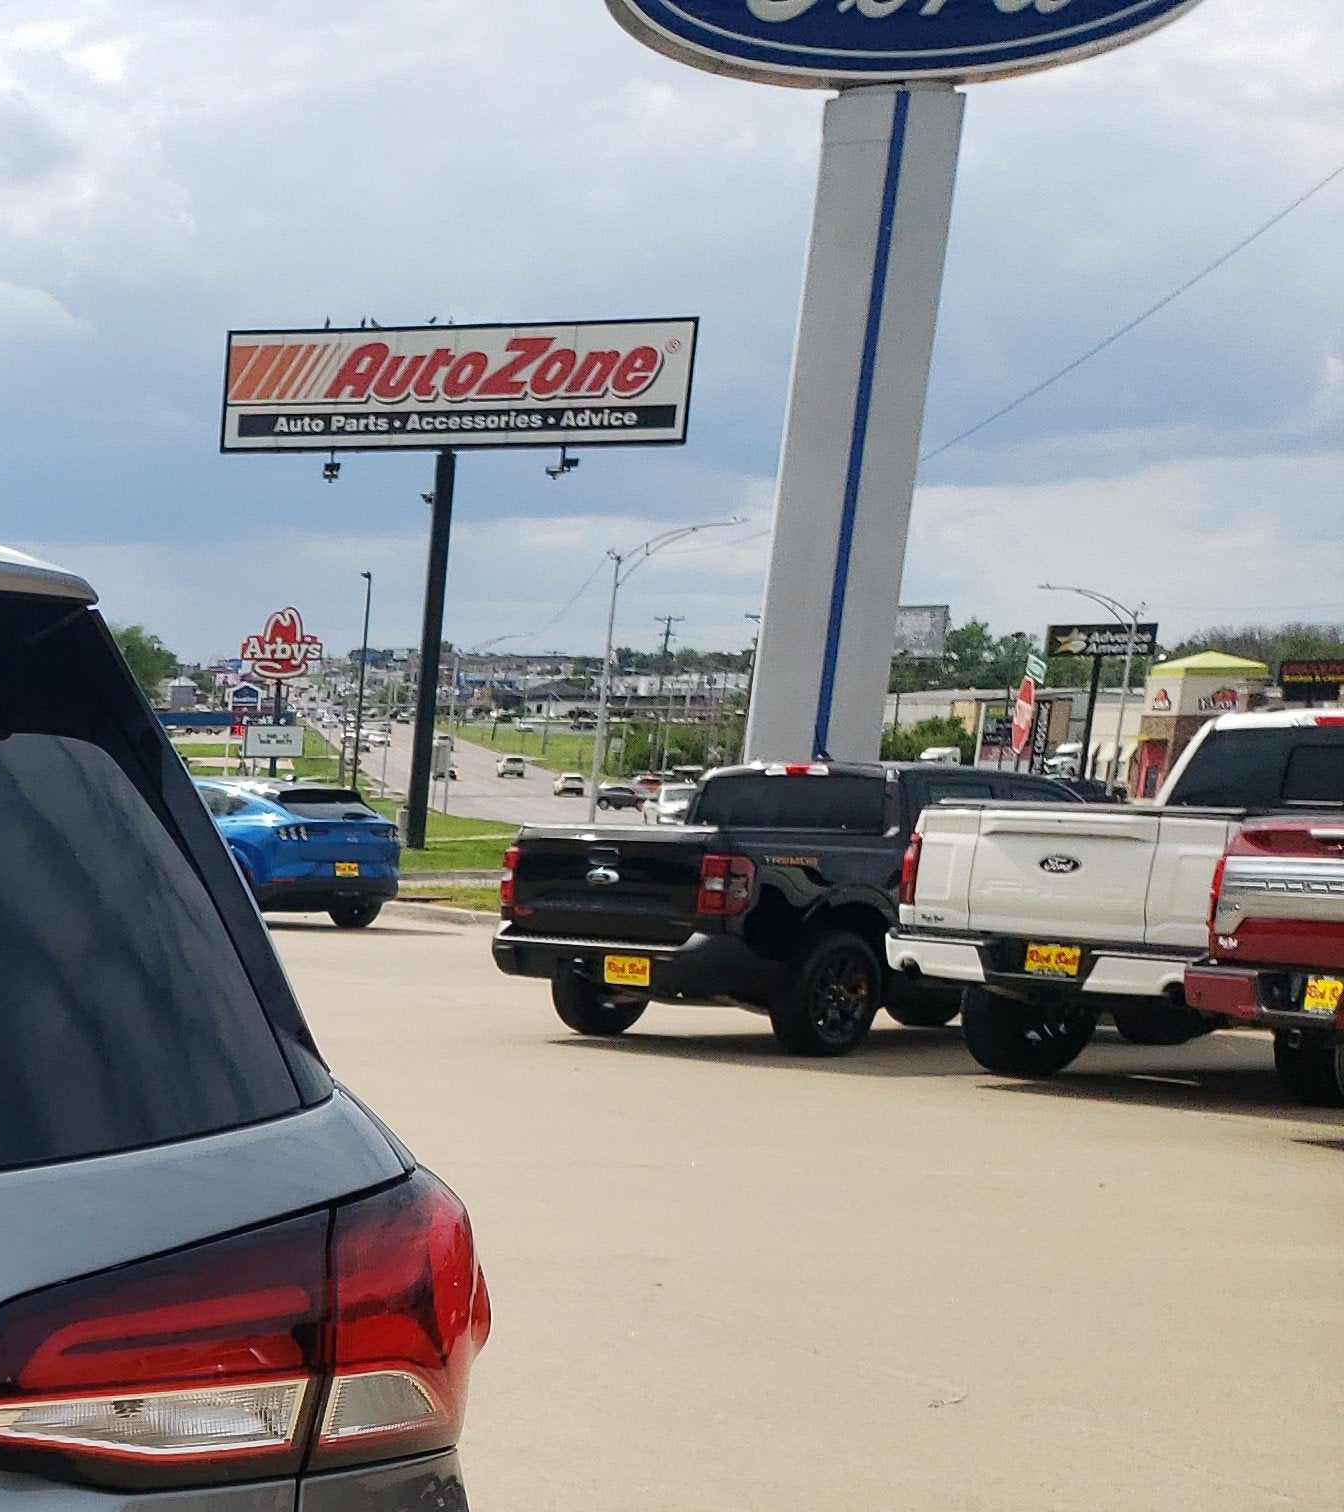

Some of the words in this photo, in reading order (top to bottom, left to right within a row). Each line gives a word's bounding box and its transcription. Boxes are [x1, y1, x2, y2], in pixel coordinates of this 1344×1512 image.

[324, 336, 664, 401] AutoZone
[273, 414, 324, 434] Auto
[330, 413, 389, 432] Parts
[405, 411, 543, 430] Accessories
[560, 408, 637, 428] Advice
[243, 636, 322, 665] Arby's
